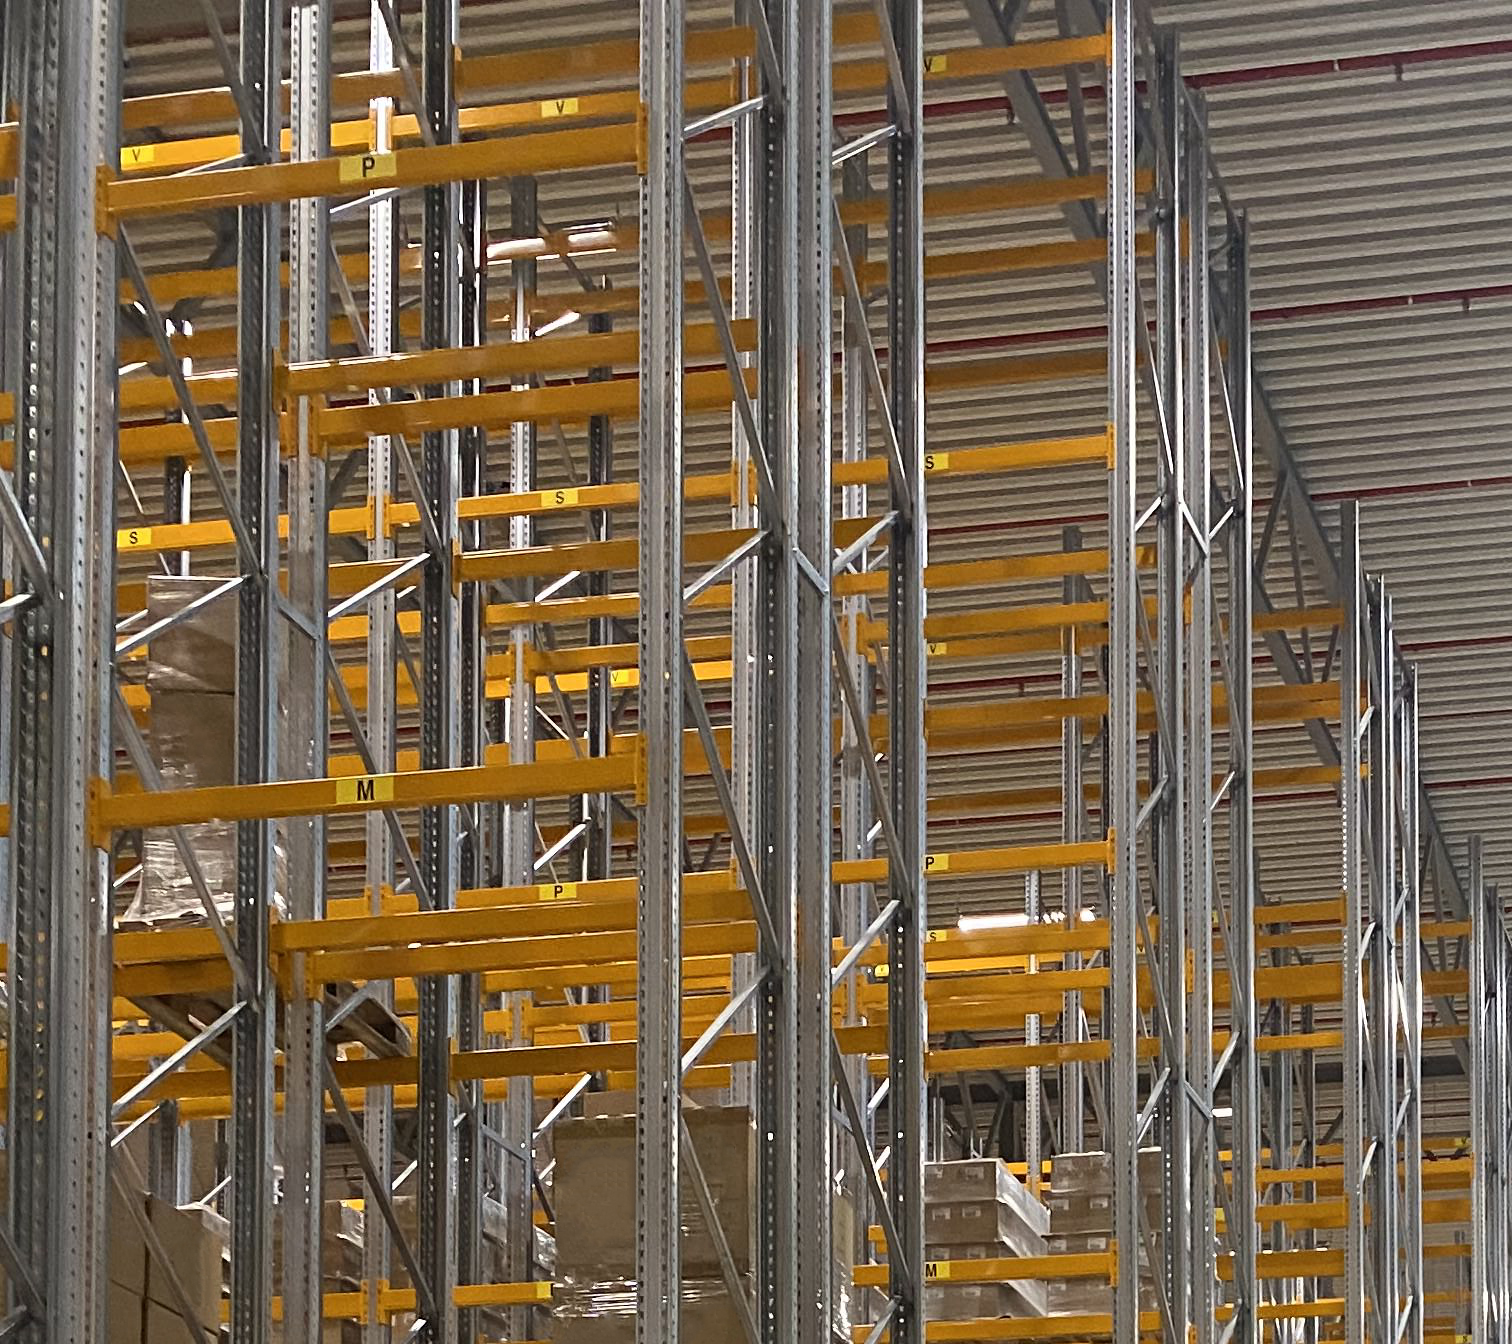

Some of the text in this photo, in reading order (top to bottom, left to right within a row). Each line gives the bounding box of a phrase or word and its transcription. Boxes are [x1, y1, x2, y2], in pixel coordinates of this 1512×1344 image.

[555, 100, 565, 115] V
[131, 147, 140, 162] V
[362, 156, 376, 178] P
[924, 455, 935, 469] S
[554, 490, 565, 504] S
[128, 530, 139, 544] S
[928, 644, 938, 655] V
[356, 780, 376, 801] M
[925, 856, 935, 870] P
[553, 885, 564, 898] P
[928, 930, 938, 943] S
[925, 1263, 937, 1278] M
